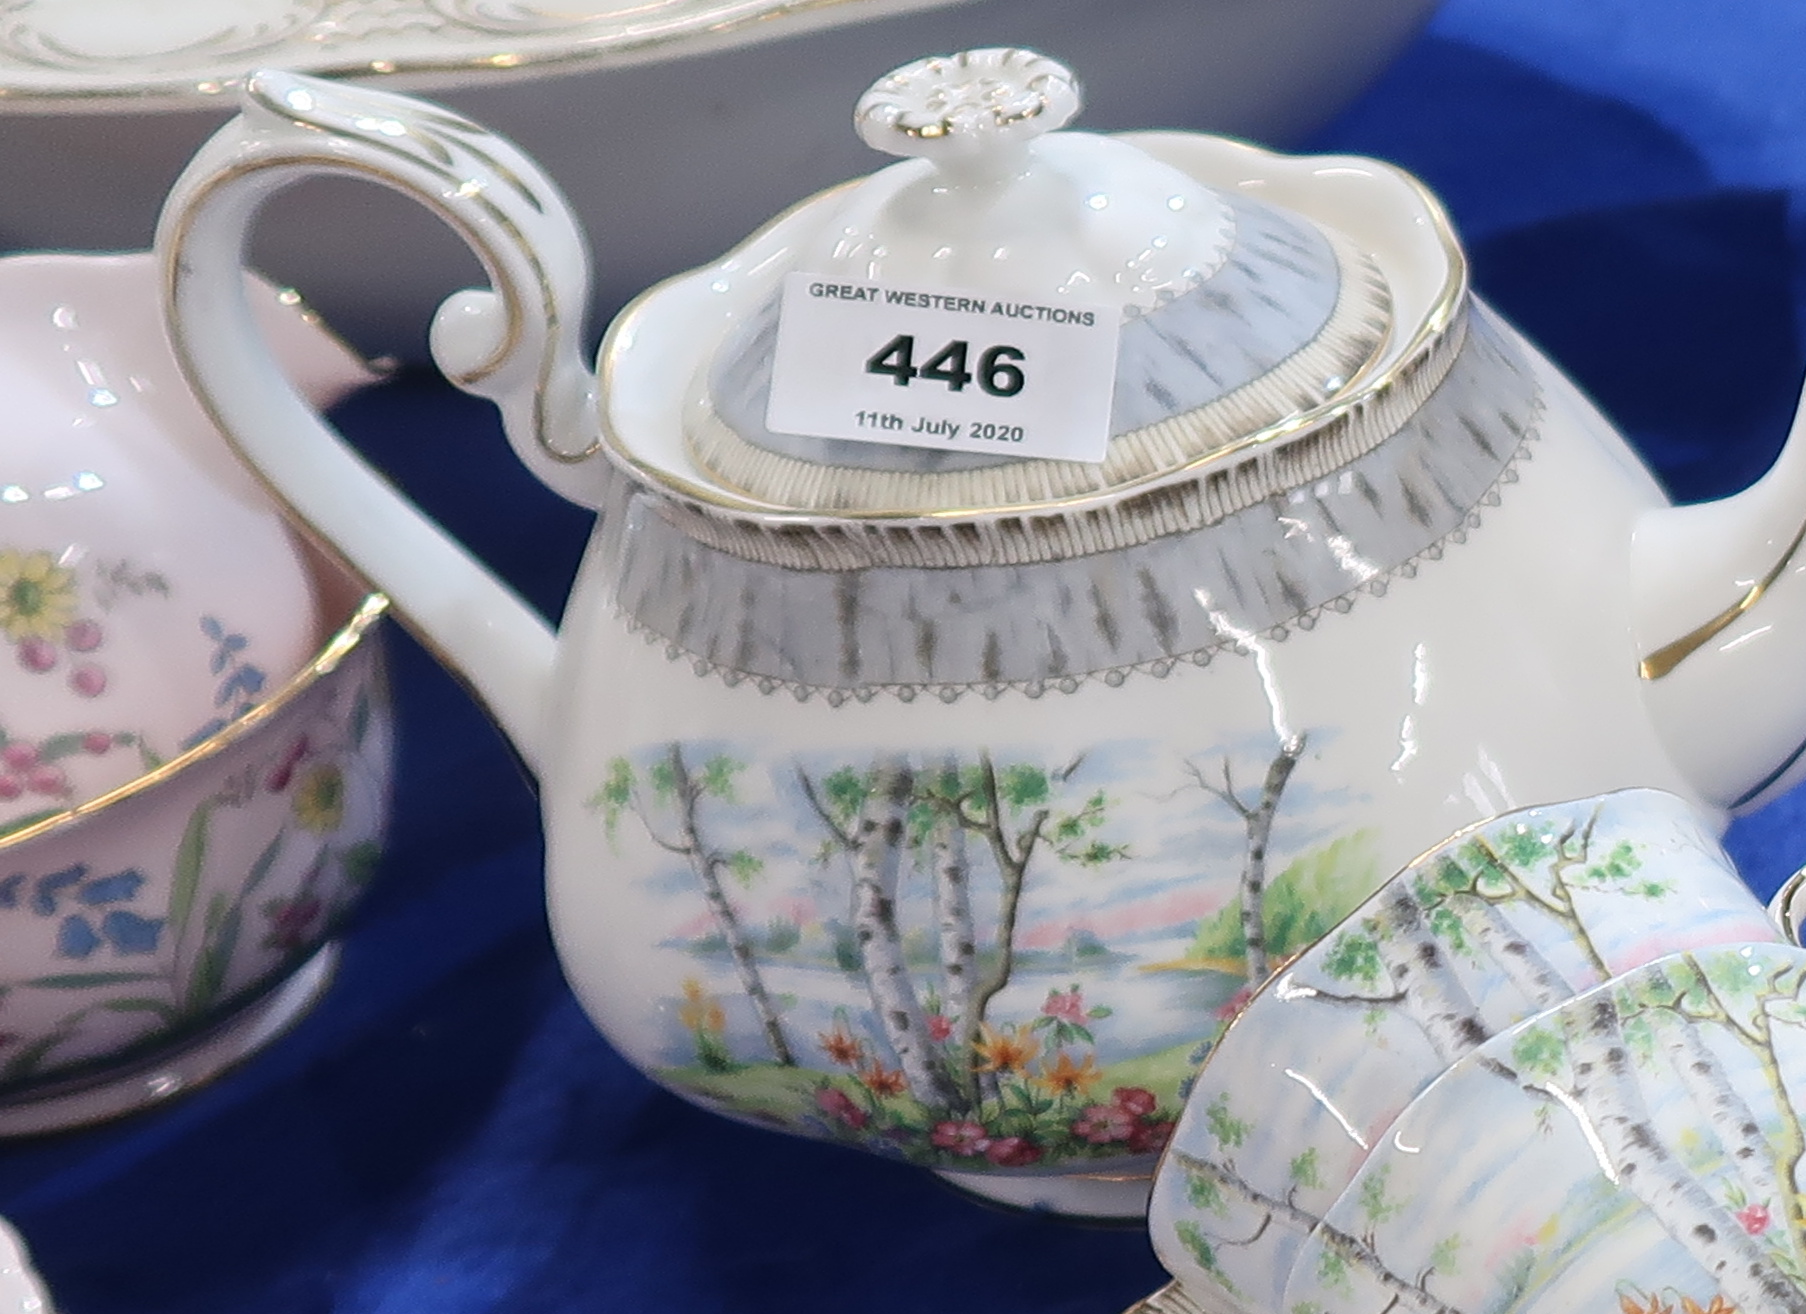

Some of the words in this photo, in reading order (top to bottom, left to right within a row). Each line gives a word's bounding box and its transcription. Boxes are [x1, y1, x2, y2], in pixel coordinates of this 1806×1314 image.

[808, 281, 879, 303] GREAT
[885, 289, 986, 315] WESTERN
[990, 300, 1096, 328] AUCTIONS
[865, 333, 1026, 398] 446
[854, 409, 904, 431] 11th
[910, 415, 960, 441] July
[969, 421, 1024, 443] 2020
